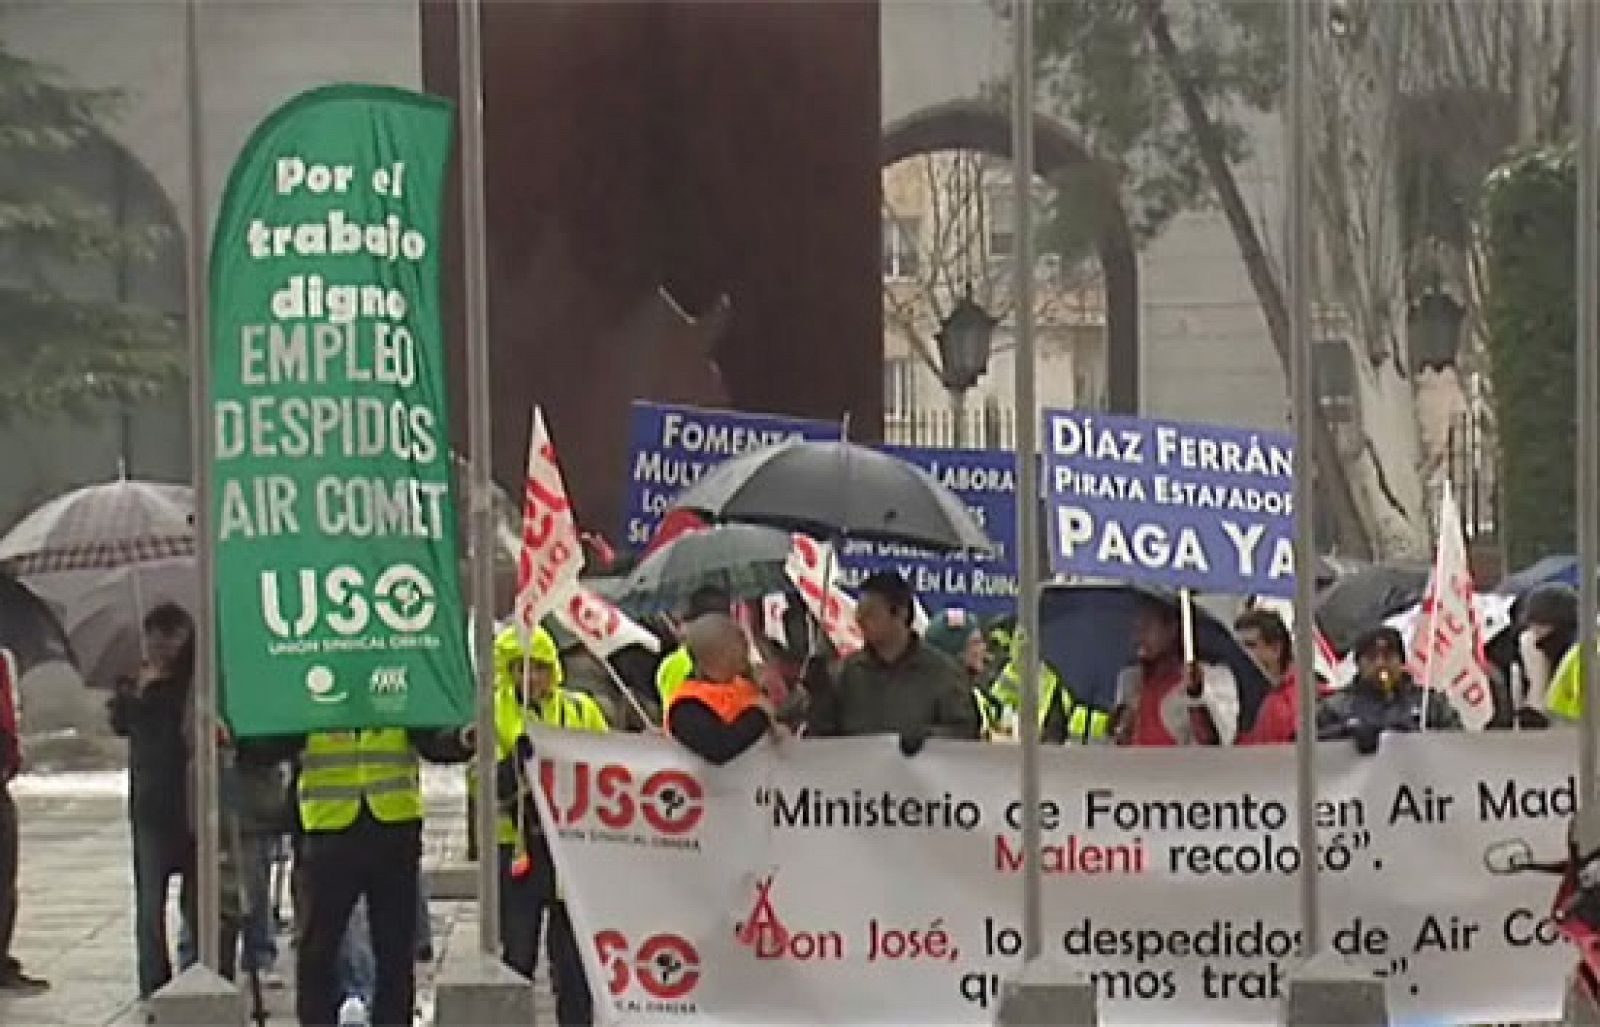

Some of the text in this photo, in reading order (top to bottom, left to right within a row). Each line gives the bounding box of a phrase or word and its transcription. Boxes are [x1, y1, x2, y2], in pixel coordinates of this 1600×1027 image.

[276, 156, 405, 199] Por el
[247, 209, 426, 261] trabajo
[271, 273, 407, 322] digno
[240, 322, 416, 387] EMPLEO
[213, 395, 438, 464] DESPIDOS
[661, 412, 804, 456] FOMENT
[1052, 415, 1293, 478] DÍAZ FERRÁN
[633, 449, 717, 487] MULT
[1055, 464, 1146, 502] PIRATA
[217, 476, 300, 542] AIR
[1058, 504, 1296, 580] PAGA YA
[259, 563, 436, 637] USO
[539, 757, 705, 836] USO
[1085, 789, 1288, 830] Fomento
[1388, 782, 1455, 827] Air
[1476, 774, 1578, 822] Mad
[994, 828, 1383, 875] Maleni recoloó”.
[868, 916, 960, 963] José,
[1331, 915, 1389, 956] de
[1412, 912, 1480, 952] Air
[1502, 906, 1568, 947] Co
[592, 929, 700, 999] SO
